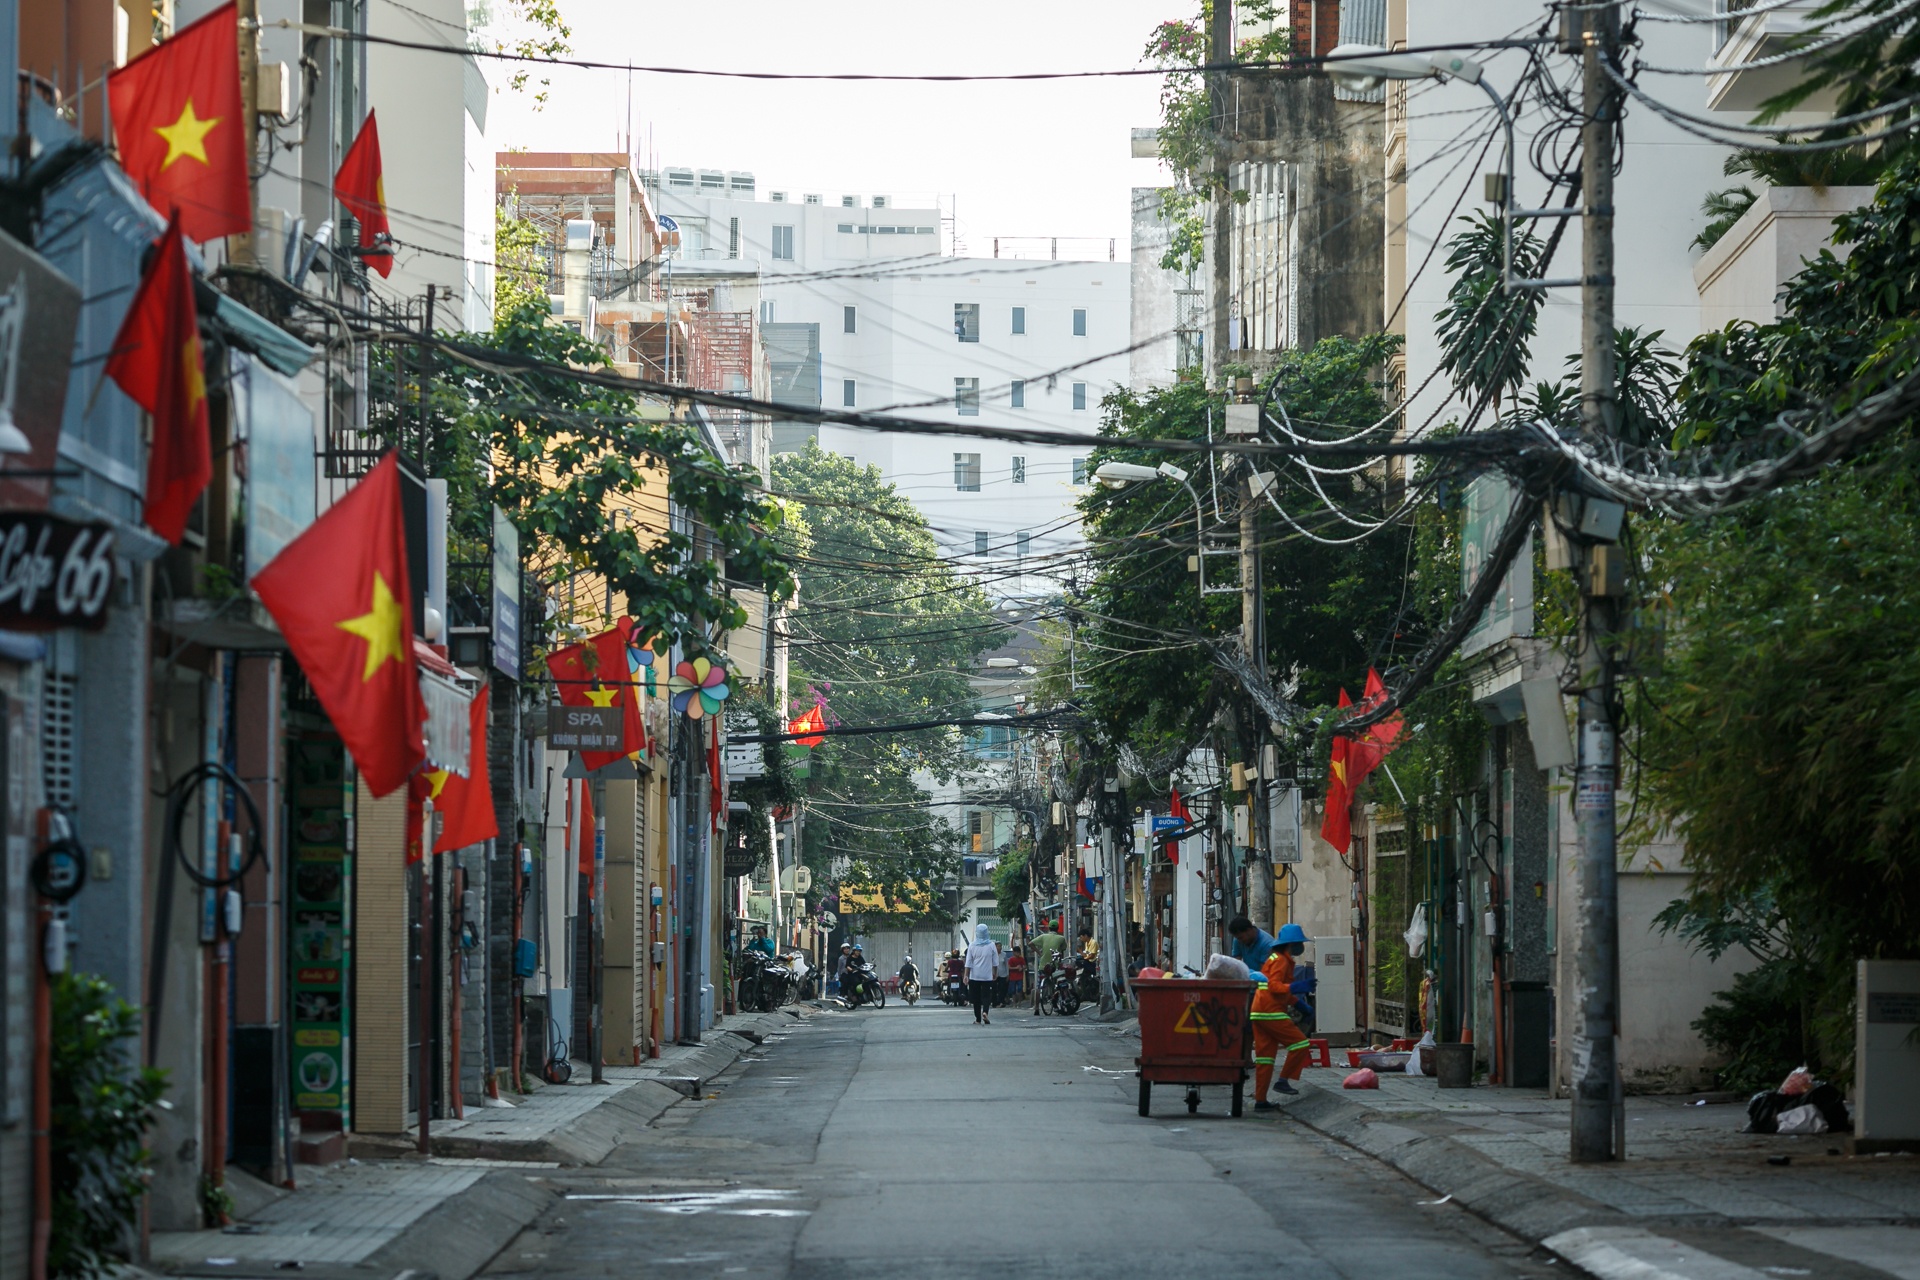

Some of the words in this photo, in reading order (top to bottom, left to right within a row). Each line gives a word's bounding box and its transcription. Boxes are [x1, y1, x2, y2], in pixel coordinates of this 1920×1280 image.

[57, 529, 112, 614] 66
[568, 712, 603, 726] SPA
[553, 732, 578, 745] KHÔNG
[581, 733, 602, 747] NHẬN
[606, 735, 617, 746] TIP
